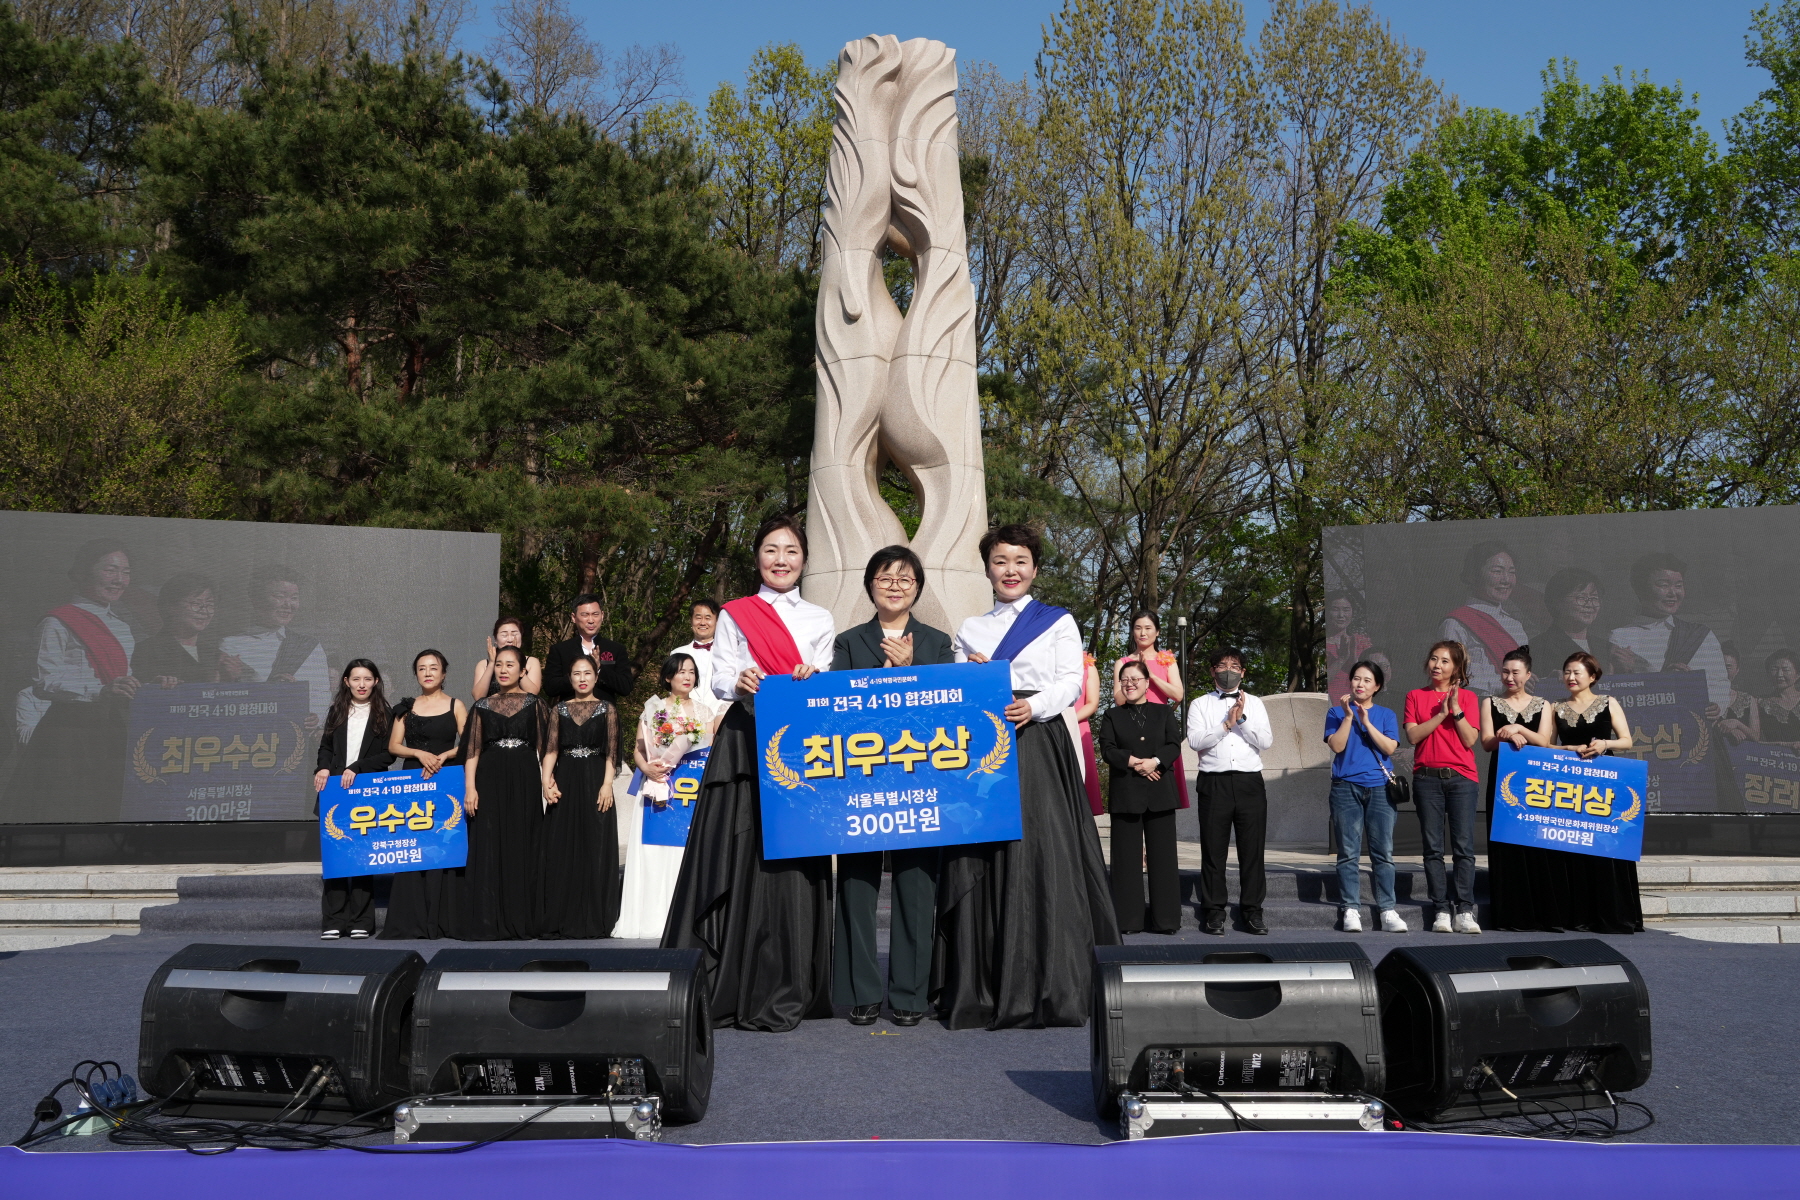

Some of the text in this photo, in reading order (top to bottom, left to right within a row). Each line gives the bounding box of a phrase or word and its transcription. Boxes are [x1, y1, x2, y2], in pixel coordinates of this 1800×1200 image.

[807, 688, 963, 712] 제1회 전국 4·19 합창대회
[1636, 692, 1676, 707] 합창대회
[188, 704, 210, 718] 전국
[212, 703, 237, 717] 4·19
[239, 702, 278, 716] 합창대회
[160, 732, 280, 774] 최우수상
[803, 725, 971, 779] 최우수상
[1542, 761, 1560, 772] 전국
[1561, 765, 1582, 775] 4·19
[1583, 767, 1618, 780] 합창대회
[187, 784, 253, 800] 서울특별시장상
[363, 787, 380, 797] 전국
[381, 785, 402, 795] 4·19
[403, 782, 437, 793] 합창대회
[846, 788, 938, 809] 서울특별시장상
[1525, 777, 1615, 816] 장려상
[185, 799, 252, 821] 300만원
[350, 800, 436, 835] 우수상
[846, 806, 941, 837] 300만원
[372, 838, 417, 850] 강북구청장상
[1541, 827, 1594, 846] 100만원
[368, 848, 423, 866] 200만원
[1252, 1053, 1262, 1068] M12
[534, 1076, 545, 1091] M12
